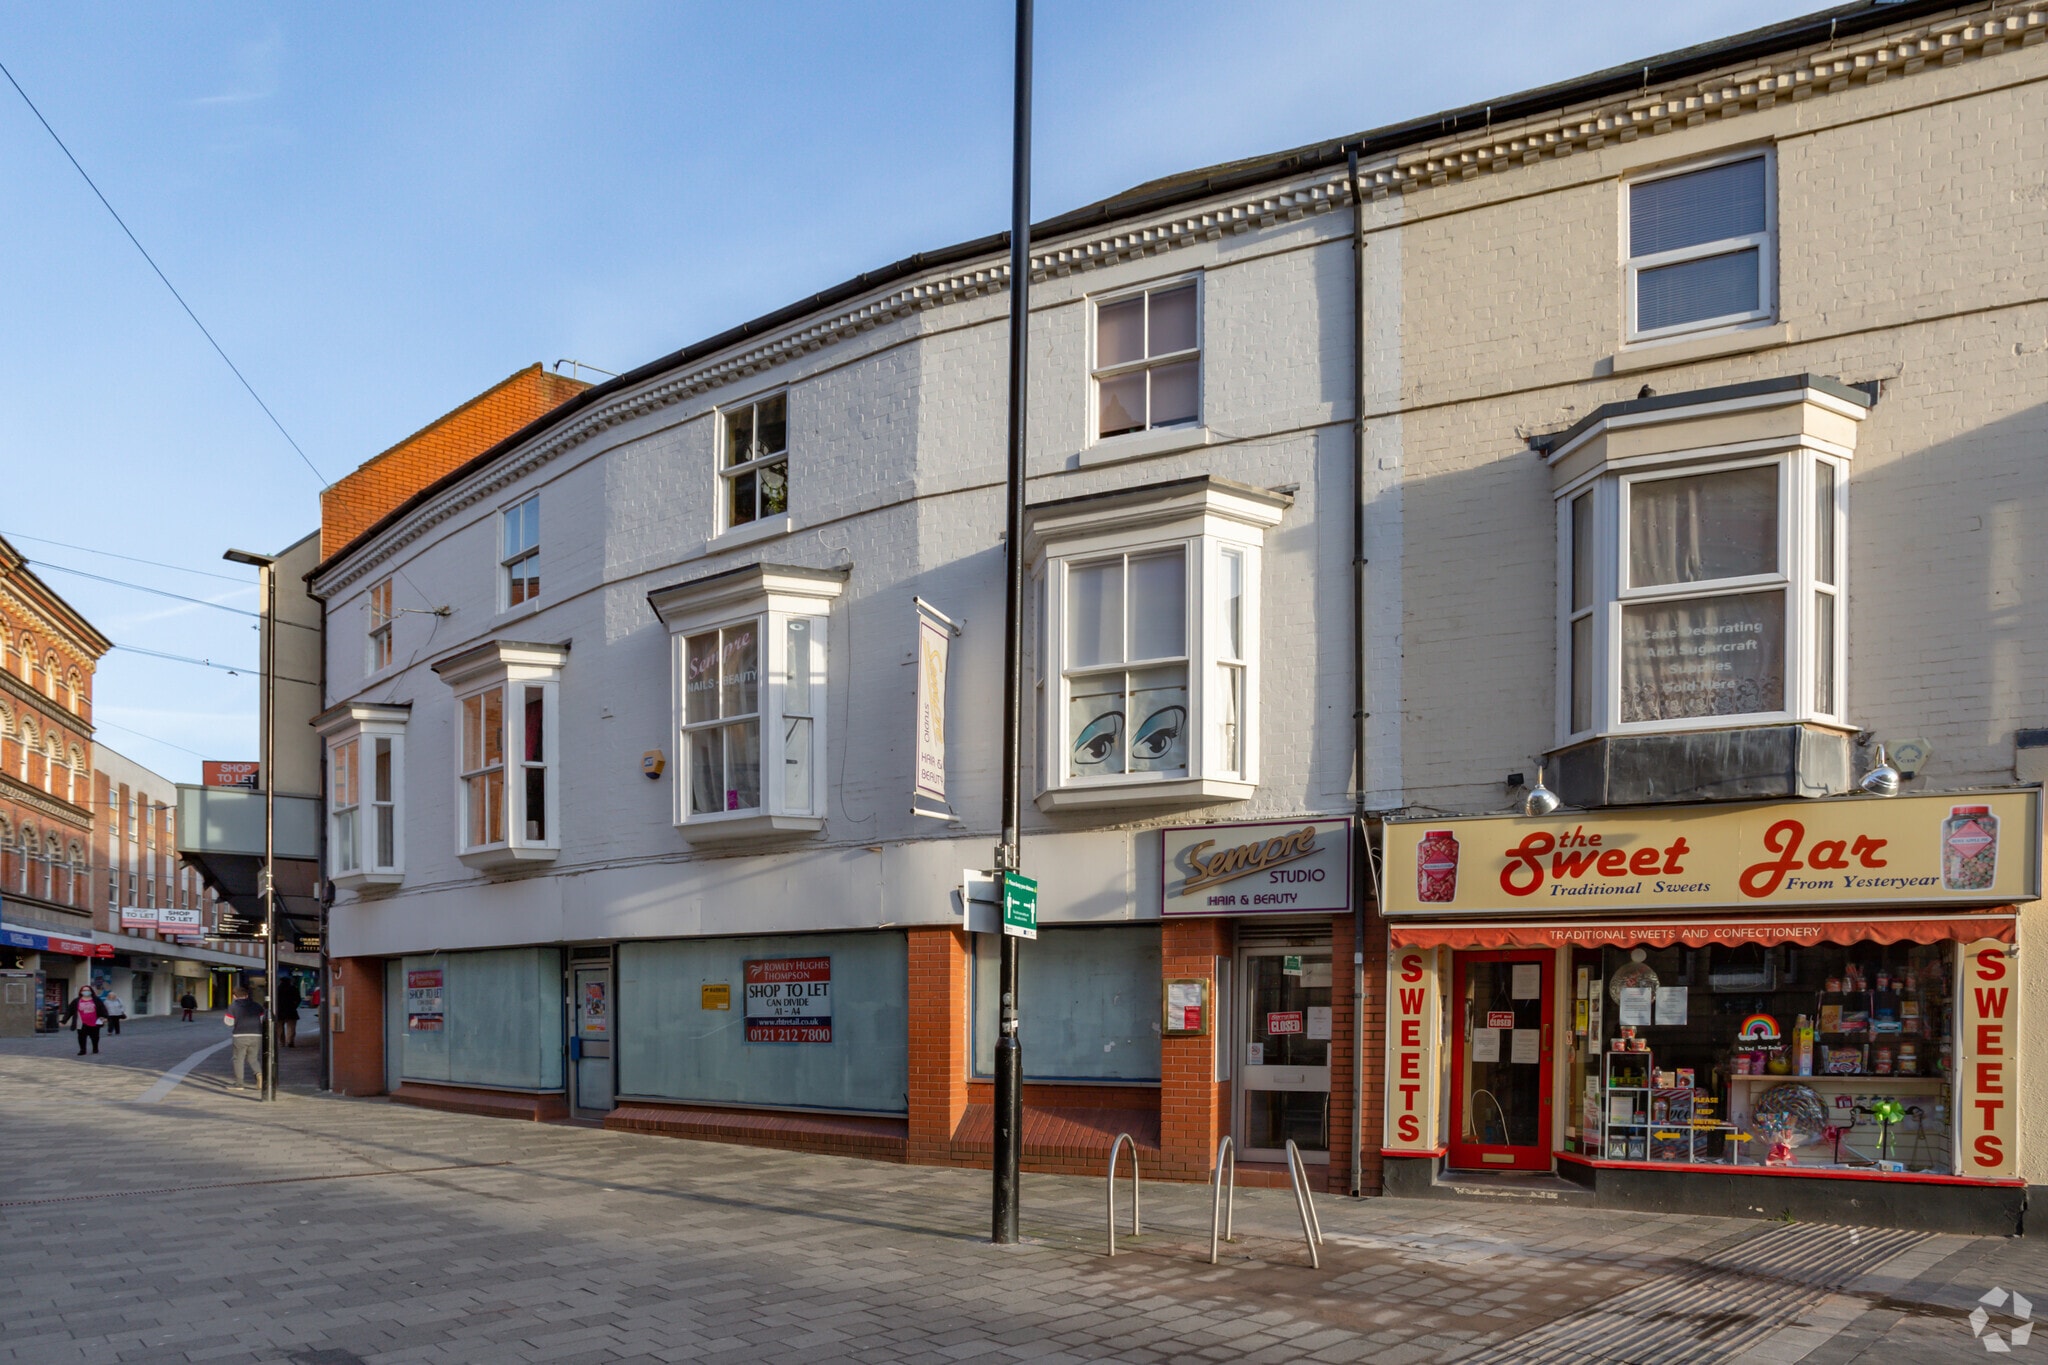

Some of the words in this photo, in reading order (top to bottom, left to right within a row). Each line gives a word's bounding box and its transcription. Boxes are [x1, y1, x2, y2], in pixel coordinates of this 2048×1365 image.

[1642, 629, 1677, 640] Cake
[1684, 622, 1763, 637] Decorating
[1647, 646, 1675, 657] And
[1679, 639, 1758, 656] Sugarcraft
[689, 633, 752, 681] Sempre
[1669, 661, 1732, 675] Supplies
[687, 678, 714, 693] NAILS
[723, 670, 758, 686] BEAUTY
[1663, 681, 1696, 693] Sold
[221, 763, 252, 773] SHOP
[921, 752, 935, 768] HAIR
[217, 774, 232, 783] TO
[235, 774, 256, 784] LET
[921, 768, 944, 786] BEAUTY
[1559, 825, 1602, 848] the
[1185, 825, 1316, 886] Sempre
[1500, 831, 1691, 897] Sweet
[1738, 819, 1888, 898] Jar
[1269, 868, 1325, 884] STUDIO
[1549, 882, 1641, 897] Traditional
[1653, 880, 1711, 894] Sweets
[1785, 876, 1834, 890] From
[1844, 874, 1940, 891] Yesteryear
[1208, 895, 1235, 906] HAIR
[1240, 894, 1250, 906] &
[1254, 892, 1298, 905] BEAUTY
[1549, 930, 1627, 940] TRADITIONAL
[1630, 929, 1676, 939] SWEETS
[1681, 928, 1709, 938] AND
[1714, 927, 1821, 938] CONFECTIONERY
[764, 962, 795, 971] ROWLEY
[796, 960, 830, 971] HUGHES
[764, 971, 810, 981] THOMPSON
[409, 988, 424, 999] SHOP
[749, 984, 781, 998] SHOP
[785, 983, 804, 997] TO
[808, 982, 830, 996] LET
[766, 998, 782, 1007] CAN
[783, 998, 809, 1007] DIVIDE
[791, 1007, 801, 1016] A4
[1271, 1020, 1300, 1032] CLOSED
[750, 1029, 775, 1041] 0121
[778, 1029, 798, 1041] 212
[801, 1028, 830, 1042] 7800
[1397, 954, 1425, 1142] SWEETS
[1973, 948, 2009, 1167] SWEETS
